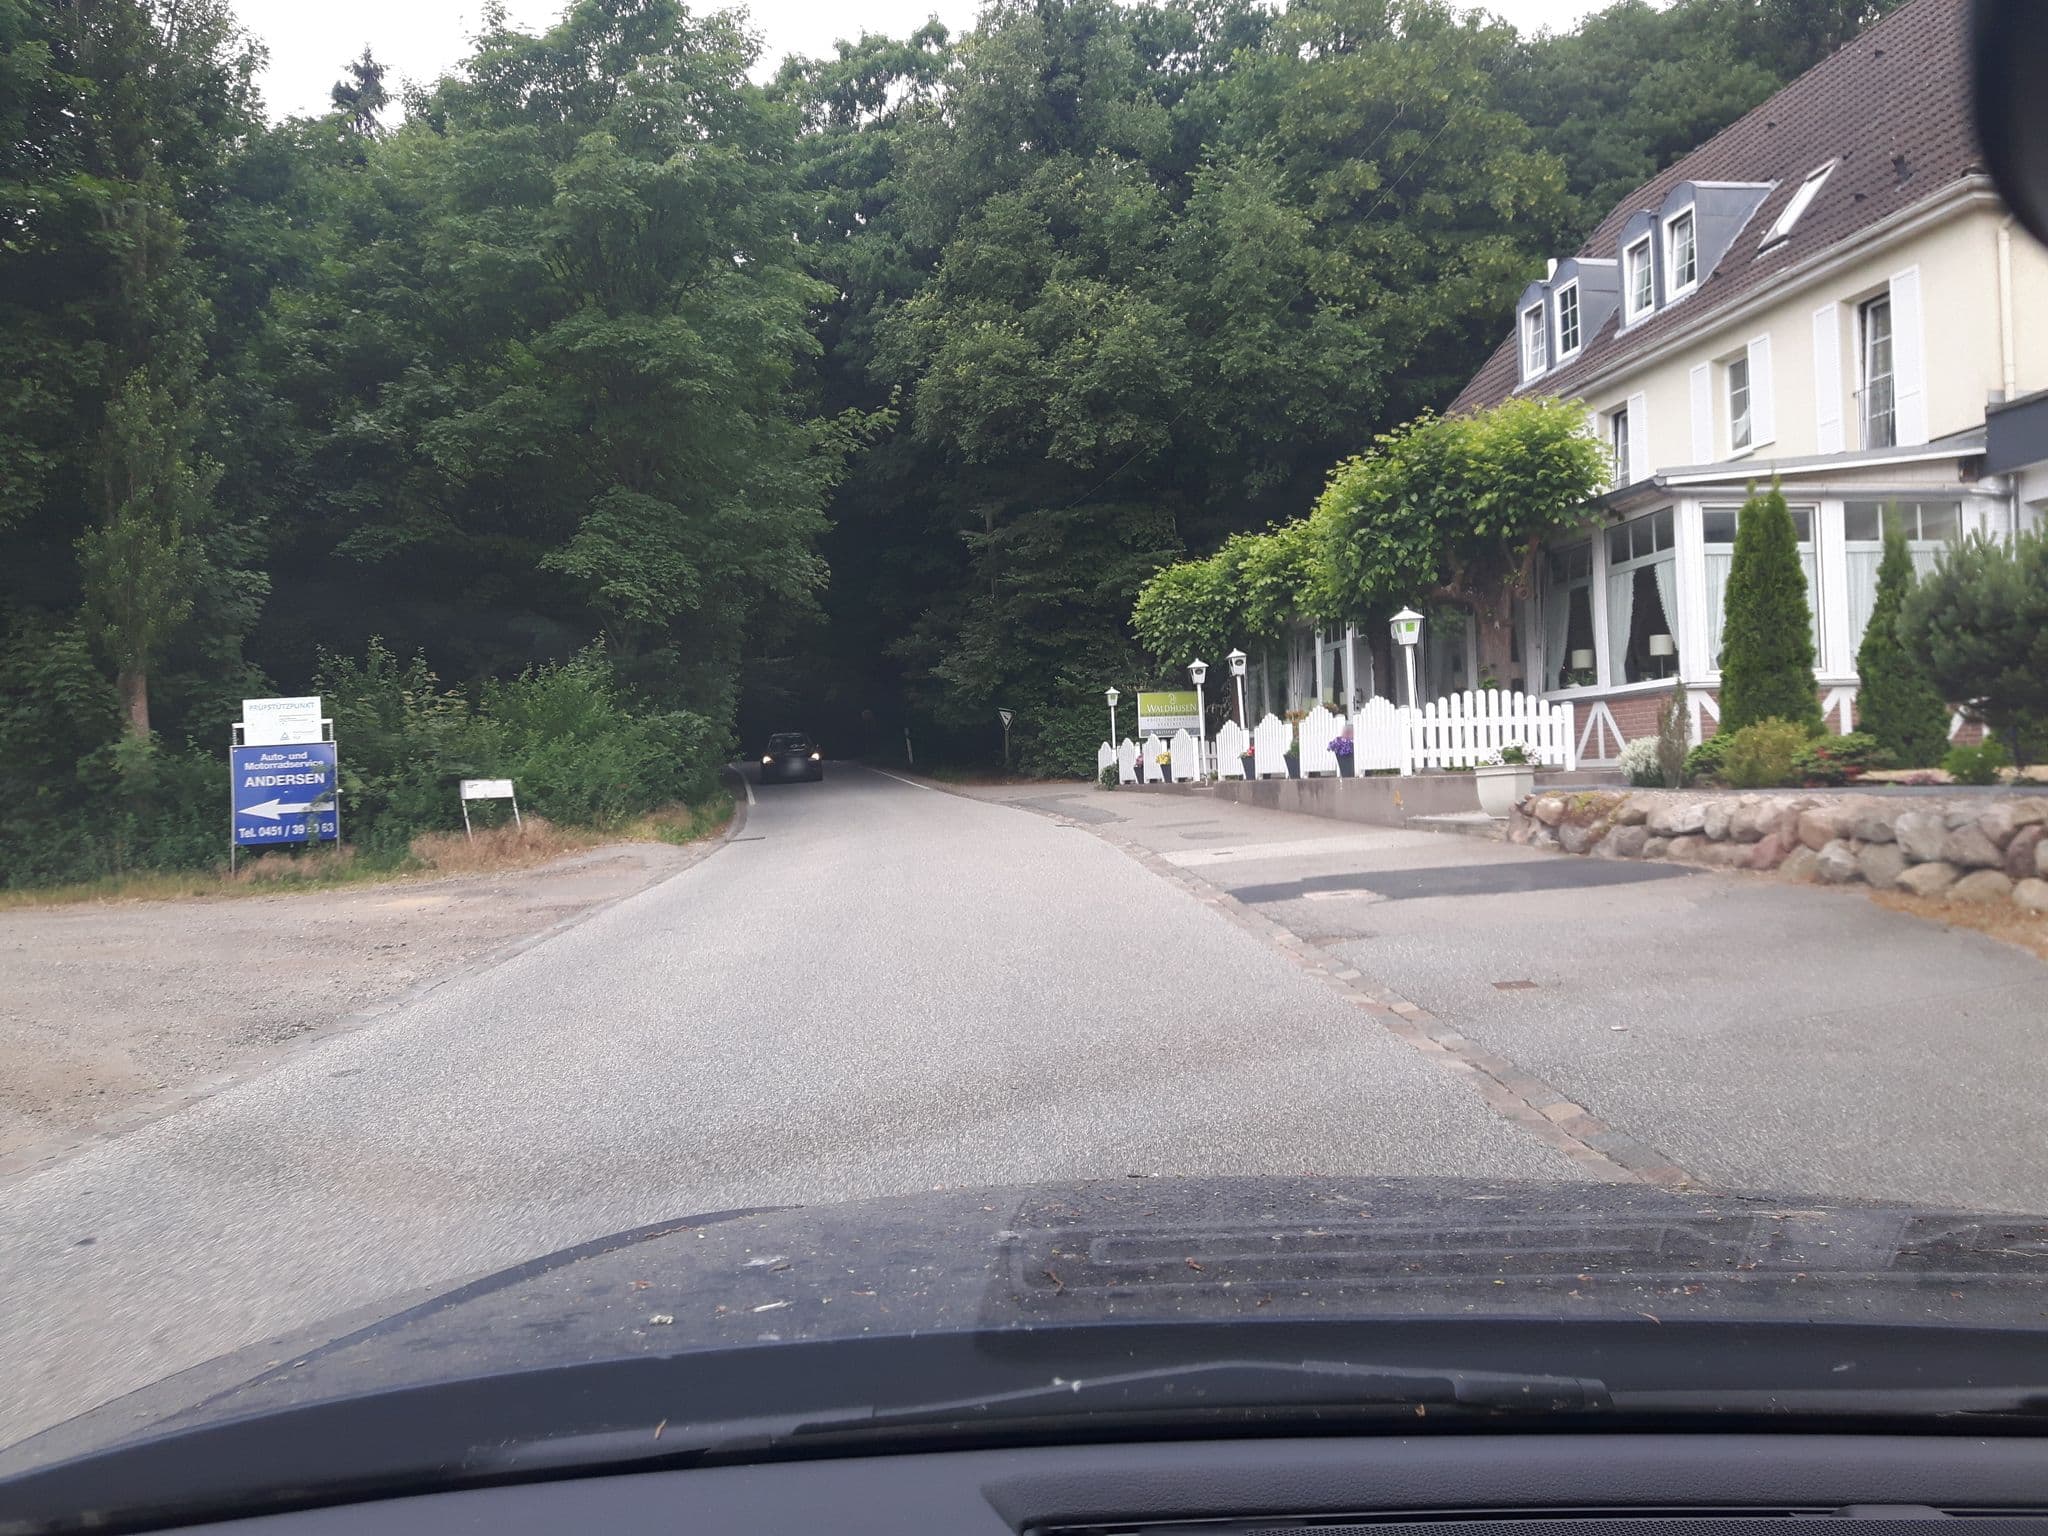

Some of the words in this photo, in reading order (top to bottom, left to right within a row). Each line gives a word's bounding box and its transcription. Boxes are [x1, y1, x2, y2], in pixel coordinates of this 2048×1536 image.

[1147, 704, 1196, 712] WALDHUSEN
[261, 753, 286, 761] Auto-
[288, 752, 307, 760] und
[244, 759, 324, 771] Motorradservice
[245, 773, 324, 788] ANDERSEN
[239, 828, 256, 838] Tel.
[258, 825, 282, 837] 0451
[285, 825, 289, 837] /
[292, 823, 305, 835] 39
